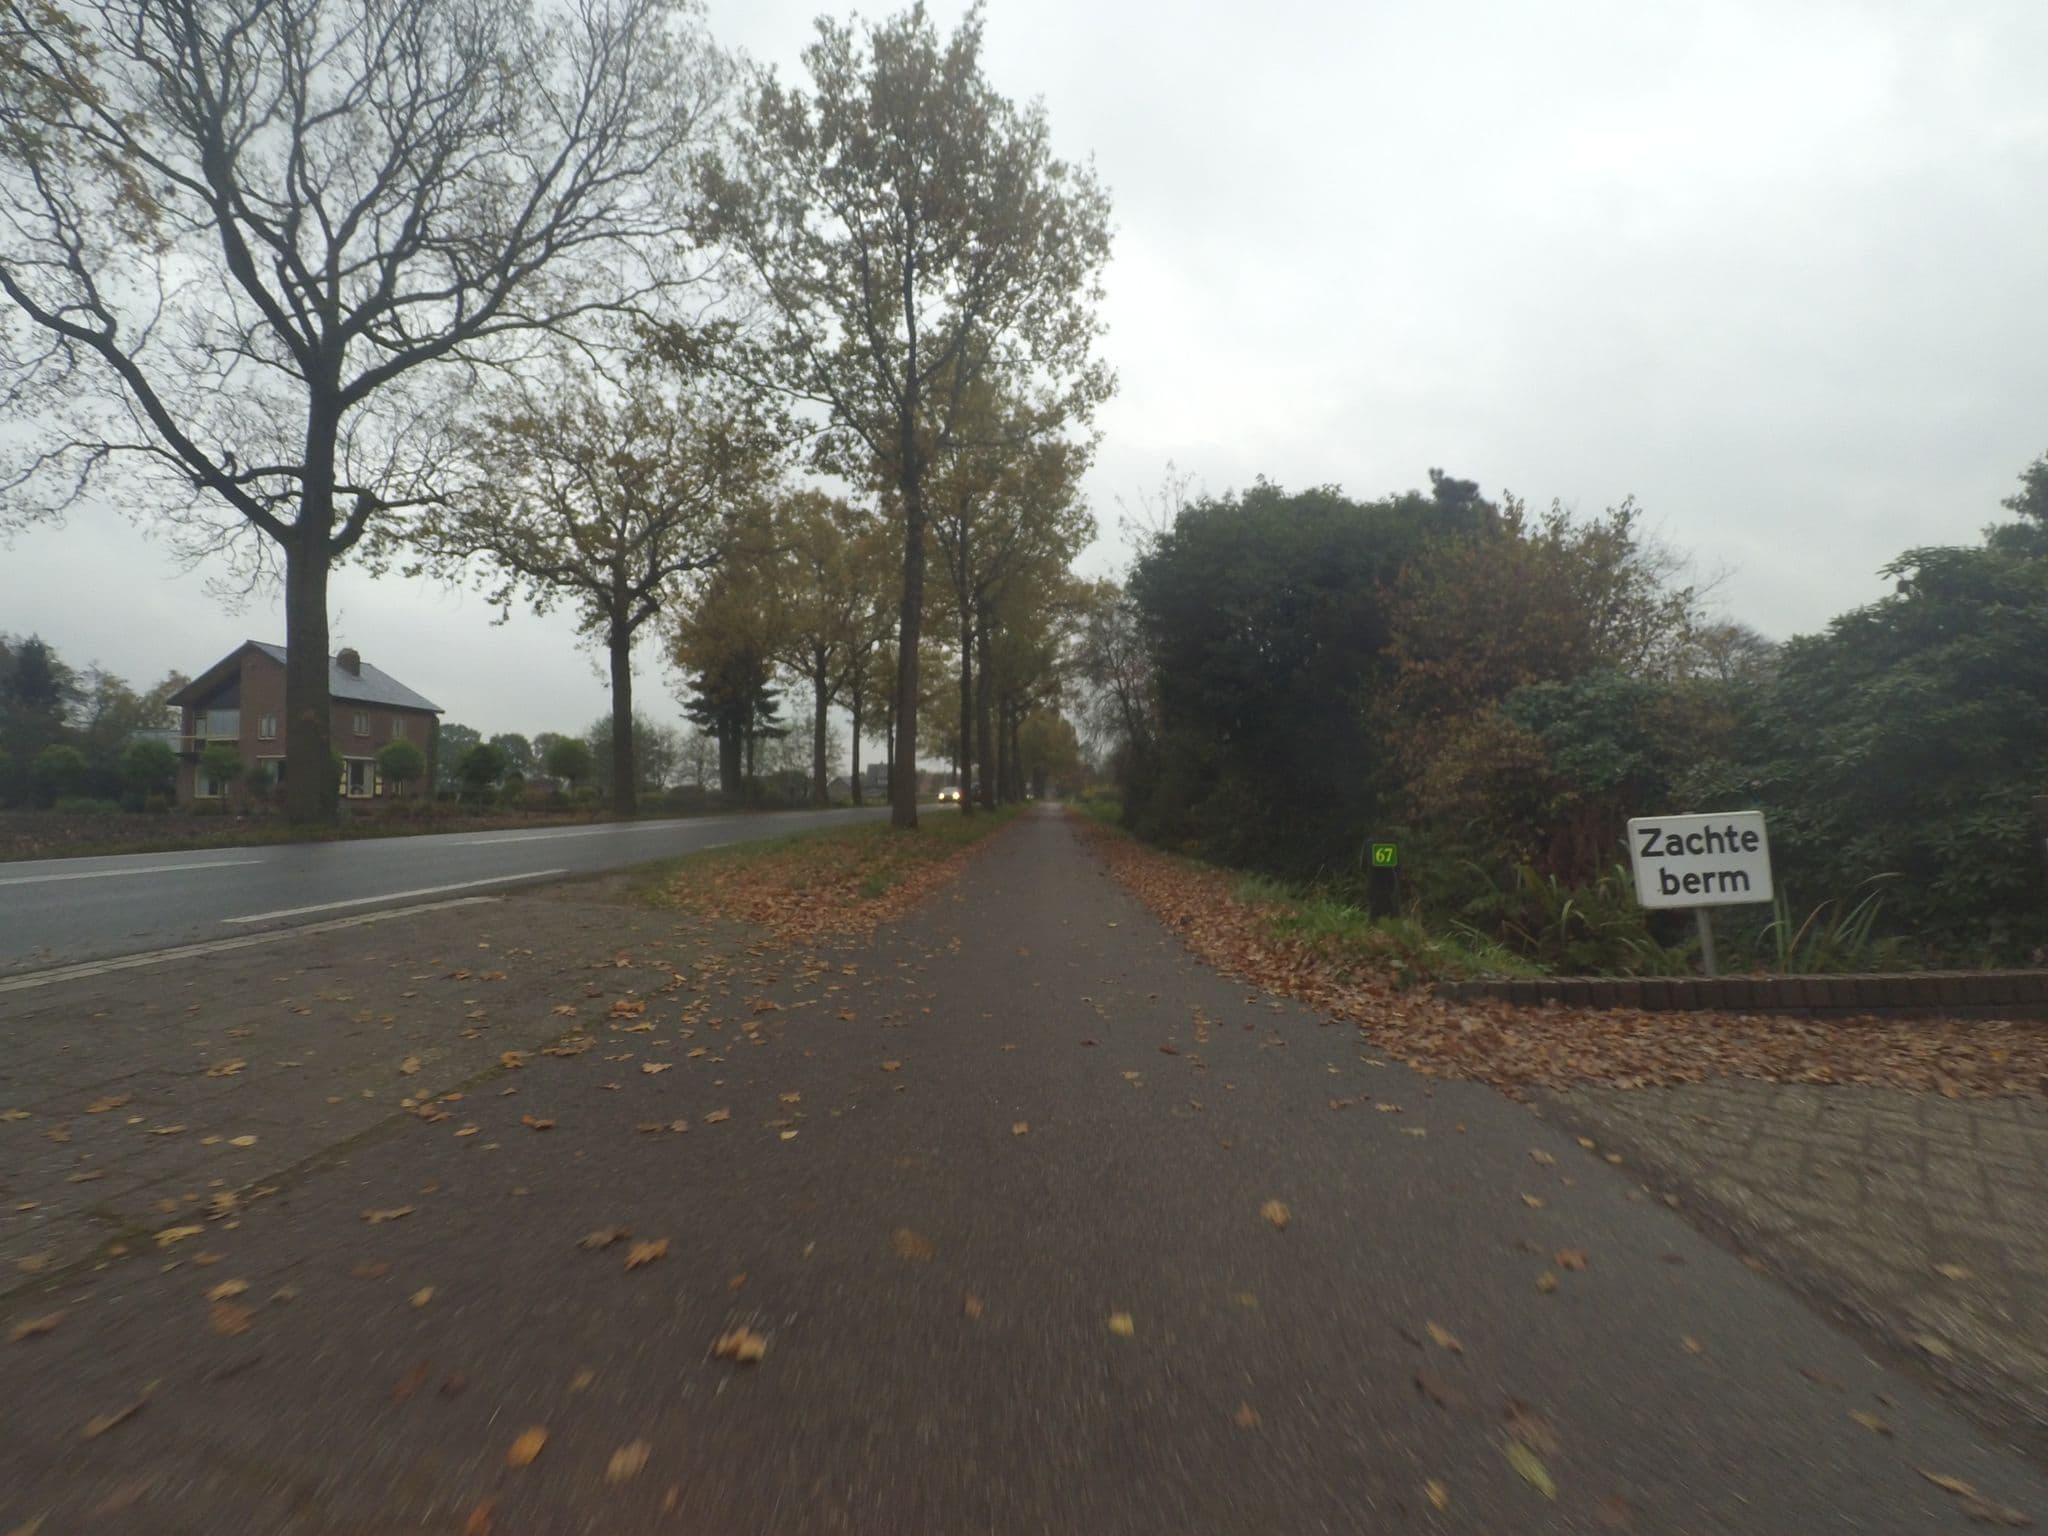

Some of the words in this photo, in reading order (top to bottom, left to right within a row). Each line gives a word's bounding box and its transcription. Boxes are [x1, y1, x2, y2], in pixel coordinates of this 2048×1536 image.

[1375, 847, 1393, 863] 67
[1638, 824, 1760, 858] Zachte
[1659, 867, 1750, 895] berm
